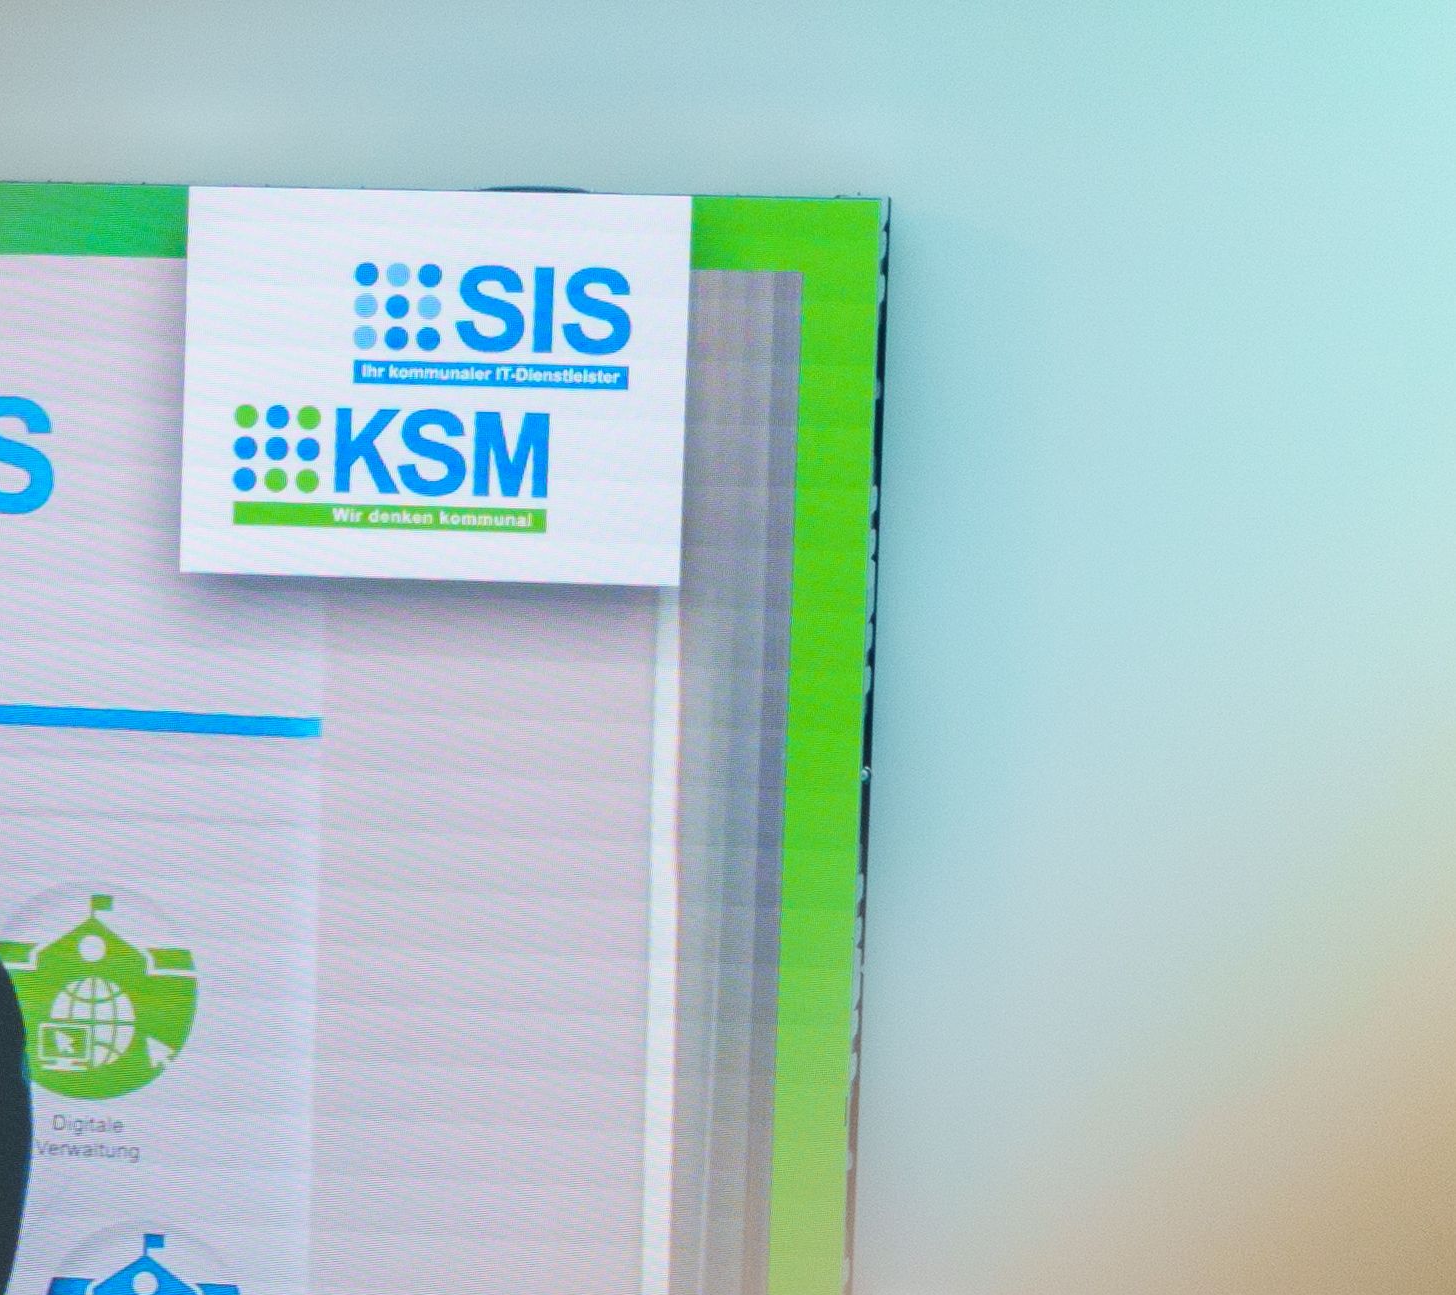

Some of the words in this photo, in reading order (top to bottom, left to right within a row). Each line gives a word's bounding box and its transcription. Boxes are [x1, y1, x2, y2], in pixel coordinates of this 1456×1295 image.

[455, 264, 631, 355] SIS
[389, 364, 492, 381] kommunaler
[495, 366, 620, 385] IT-Dienstleister
[335, 407, 550, 498] KSM
[332, 507, 362, 523] Wir
[368, 508, 433, 525] denken
[439, 510, 532, 528] kommunal
[53, 1113, 124, 1136] Digitale
